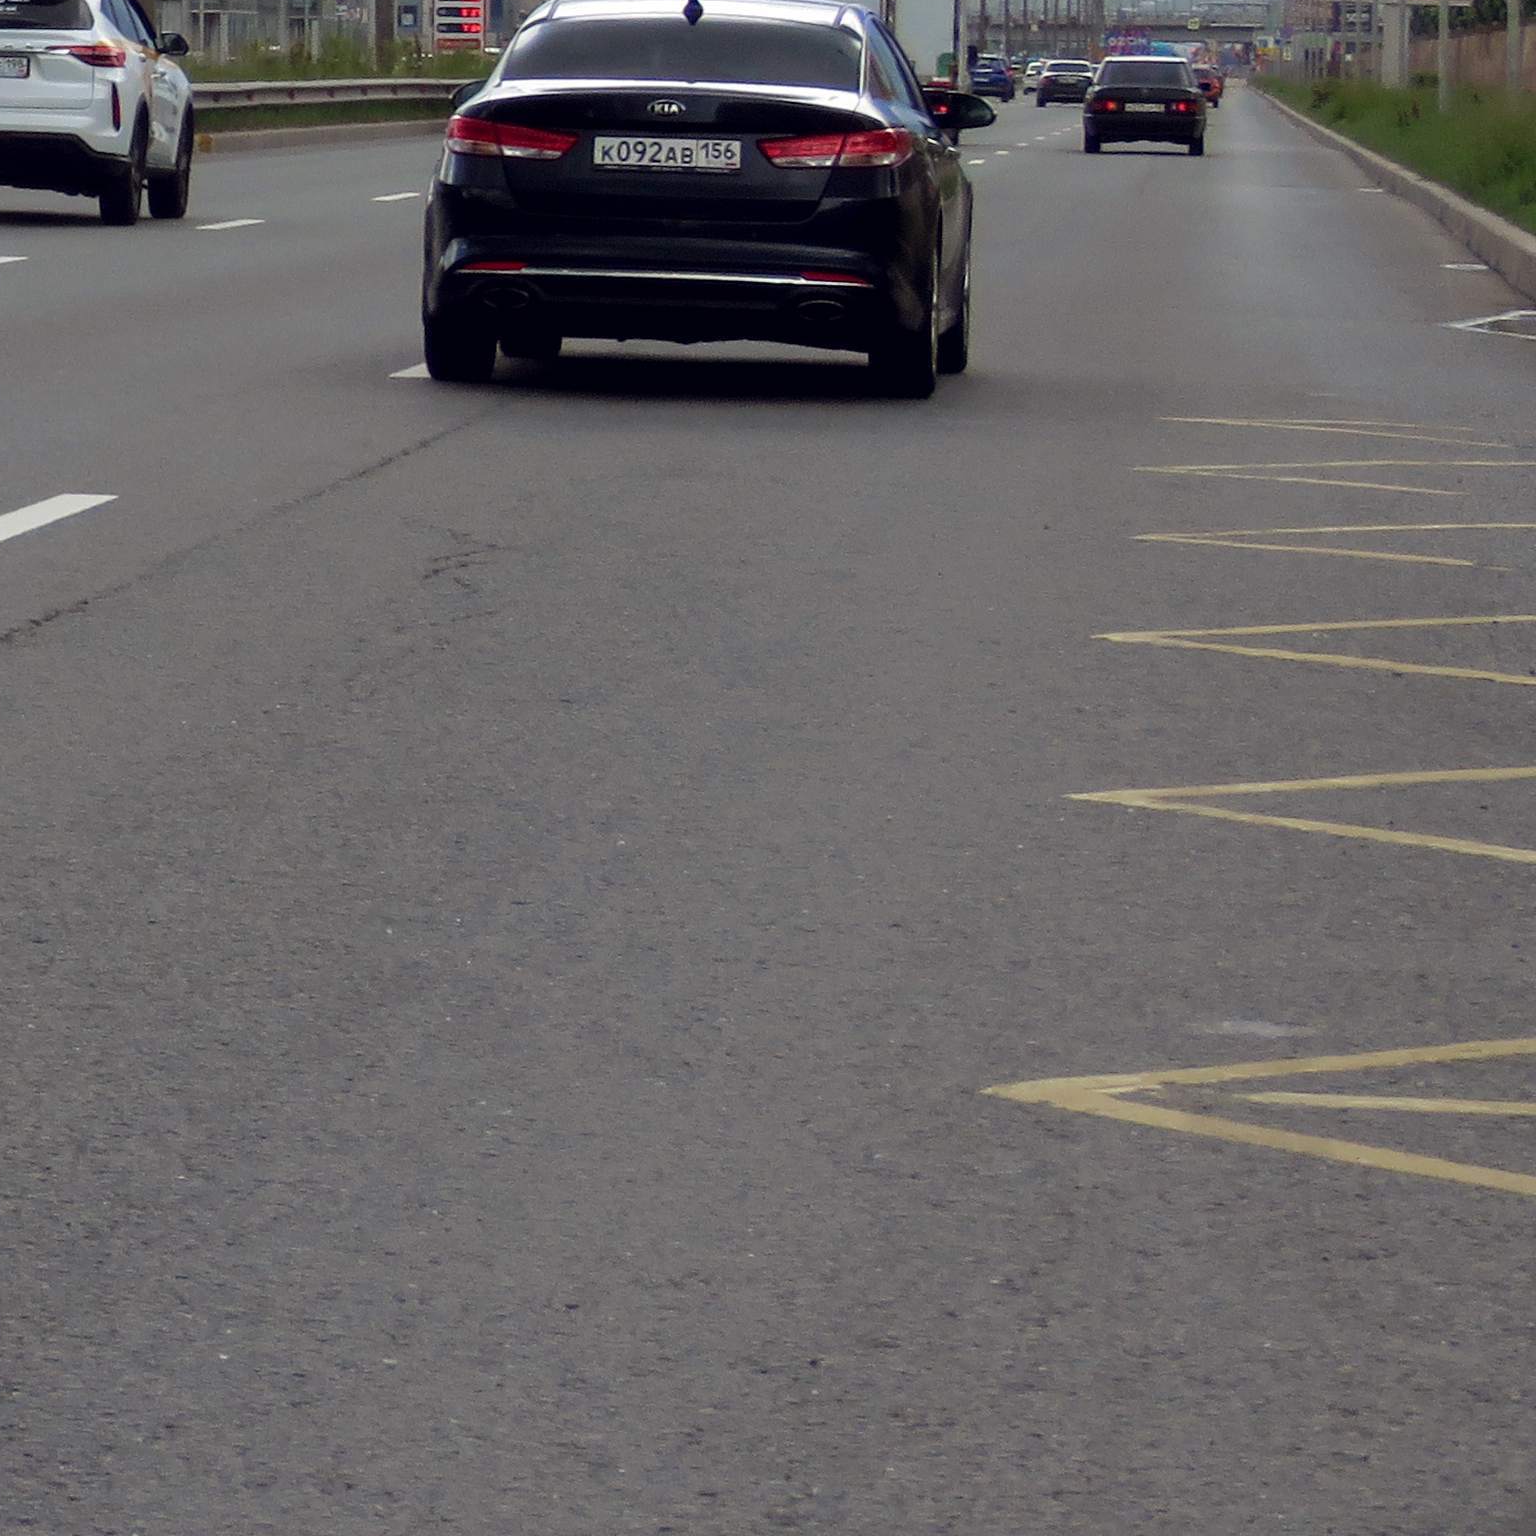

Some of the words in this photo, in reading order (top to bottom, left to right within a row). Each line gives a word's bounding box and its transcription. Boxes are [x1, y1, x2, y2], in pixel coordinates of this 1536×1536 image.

[653, 102, 679, 113] KIA
[600, 140, 695, 164] К092АВ
[699, 141, 737, 160] 156
